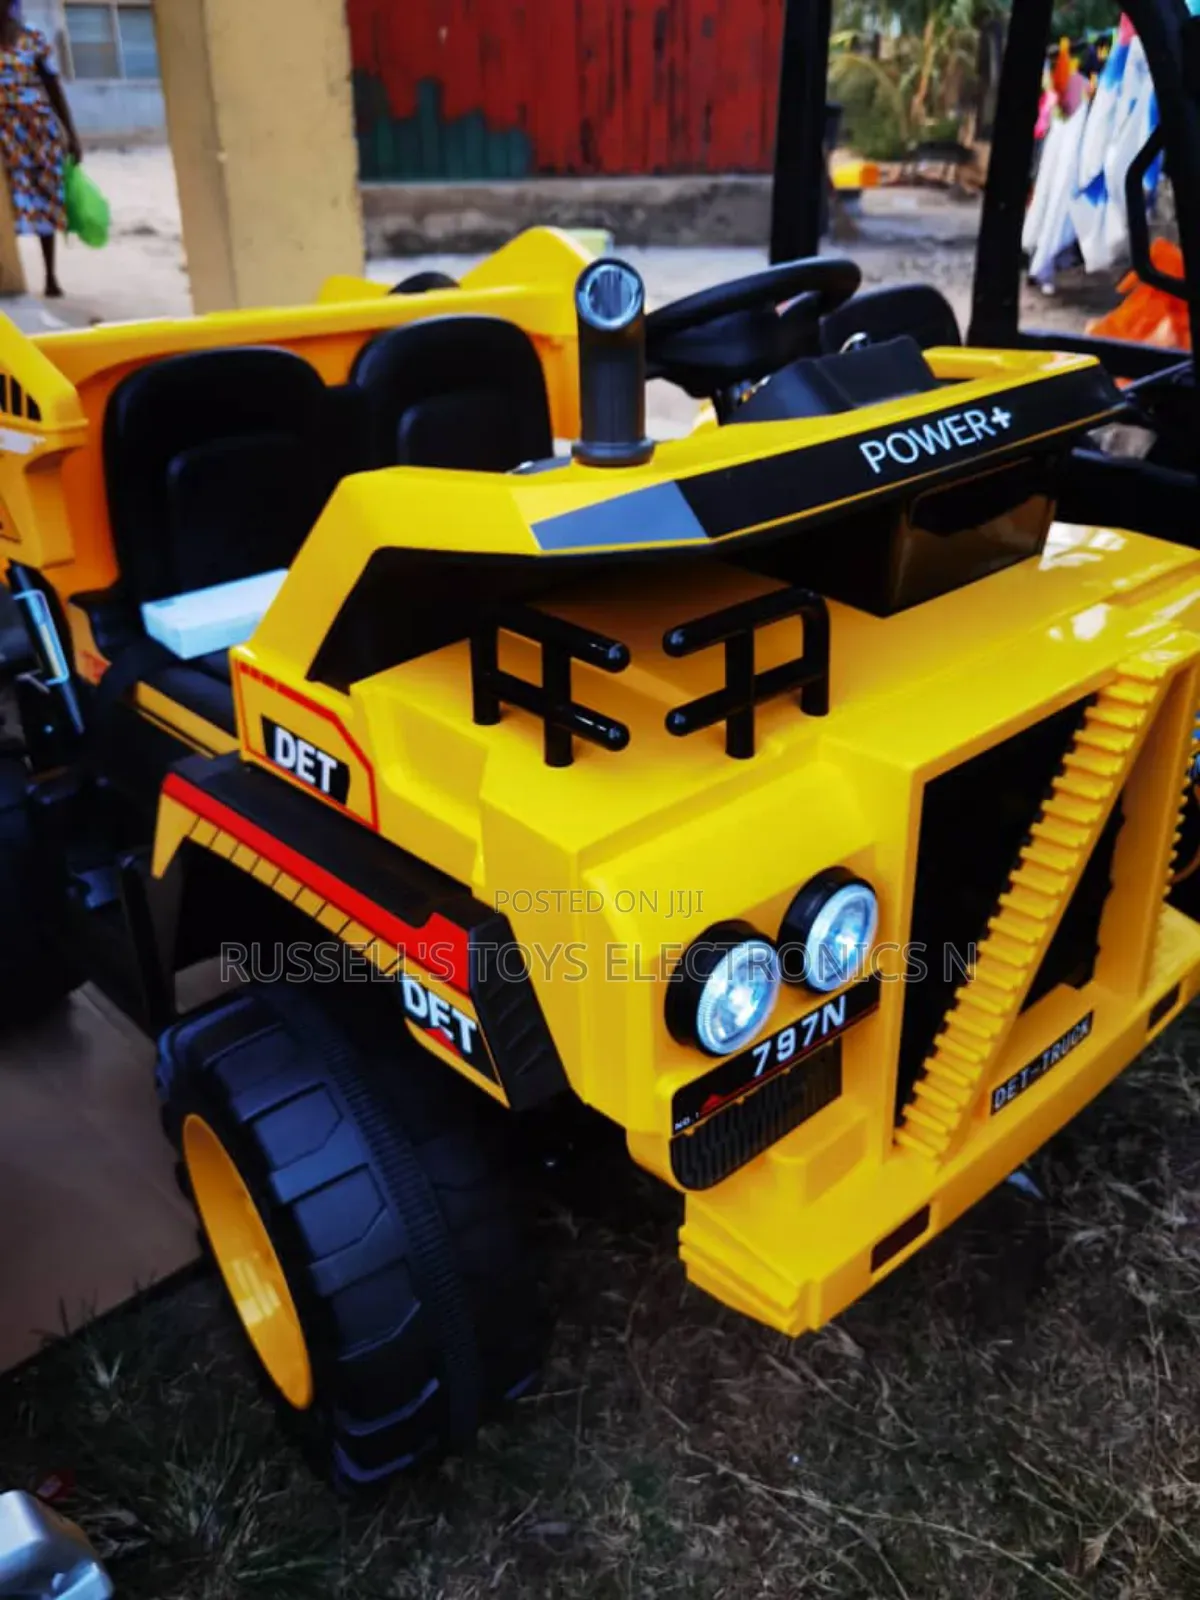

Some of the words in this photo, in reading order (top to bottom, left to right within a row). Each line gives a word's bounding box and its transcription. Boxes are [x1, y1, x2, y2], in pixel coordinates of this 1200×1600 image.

[859, 406, 1012, 474] POWER+
[274, 727, 338, 793] DET
[401, 973, 477, 1054] DET
[752, 995, 846, 1078] 797N
